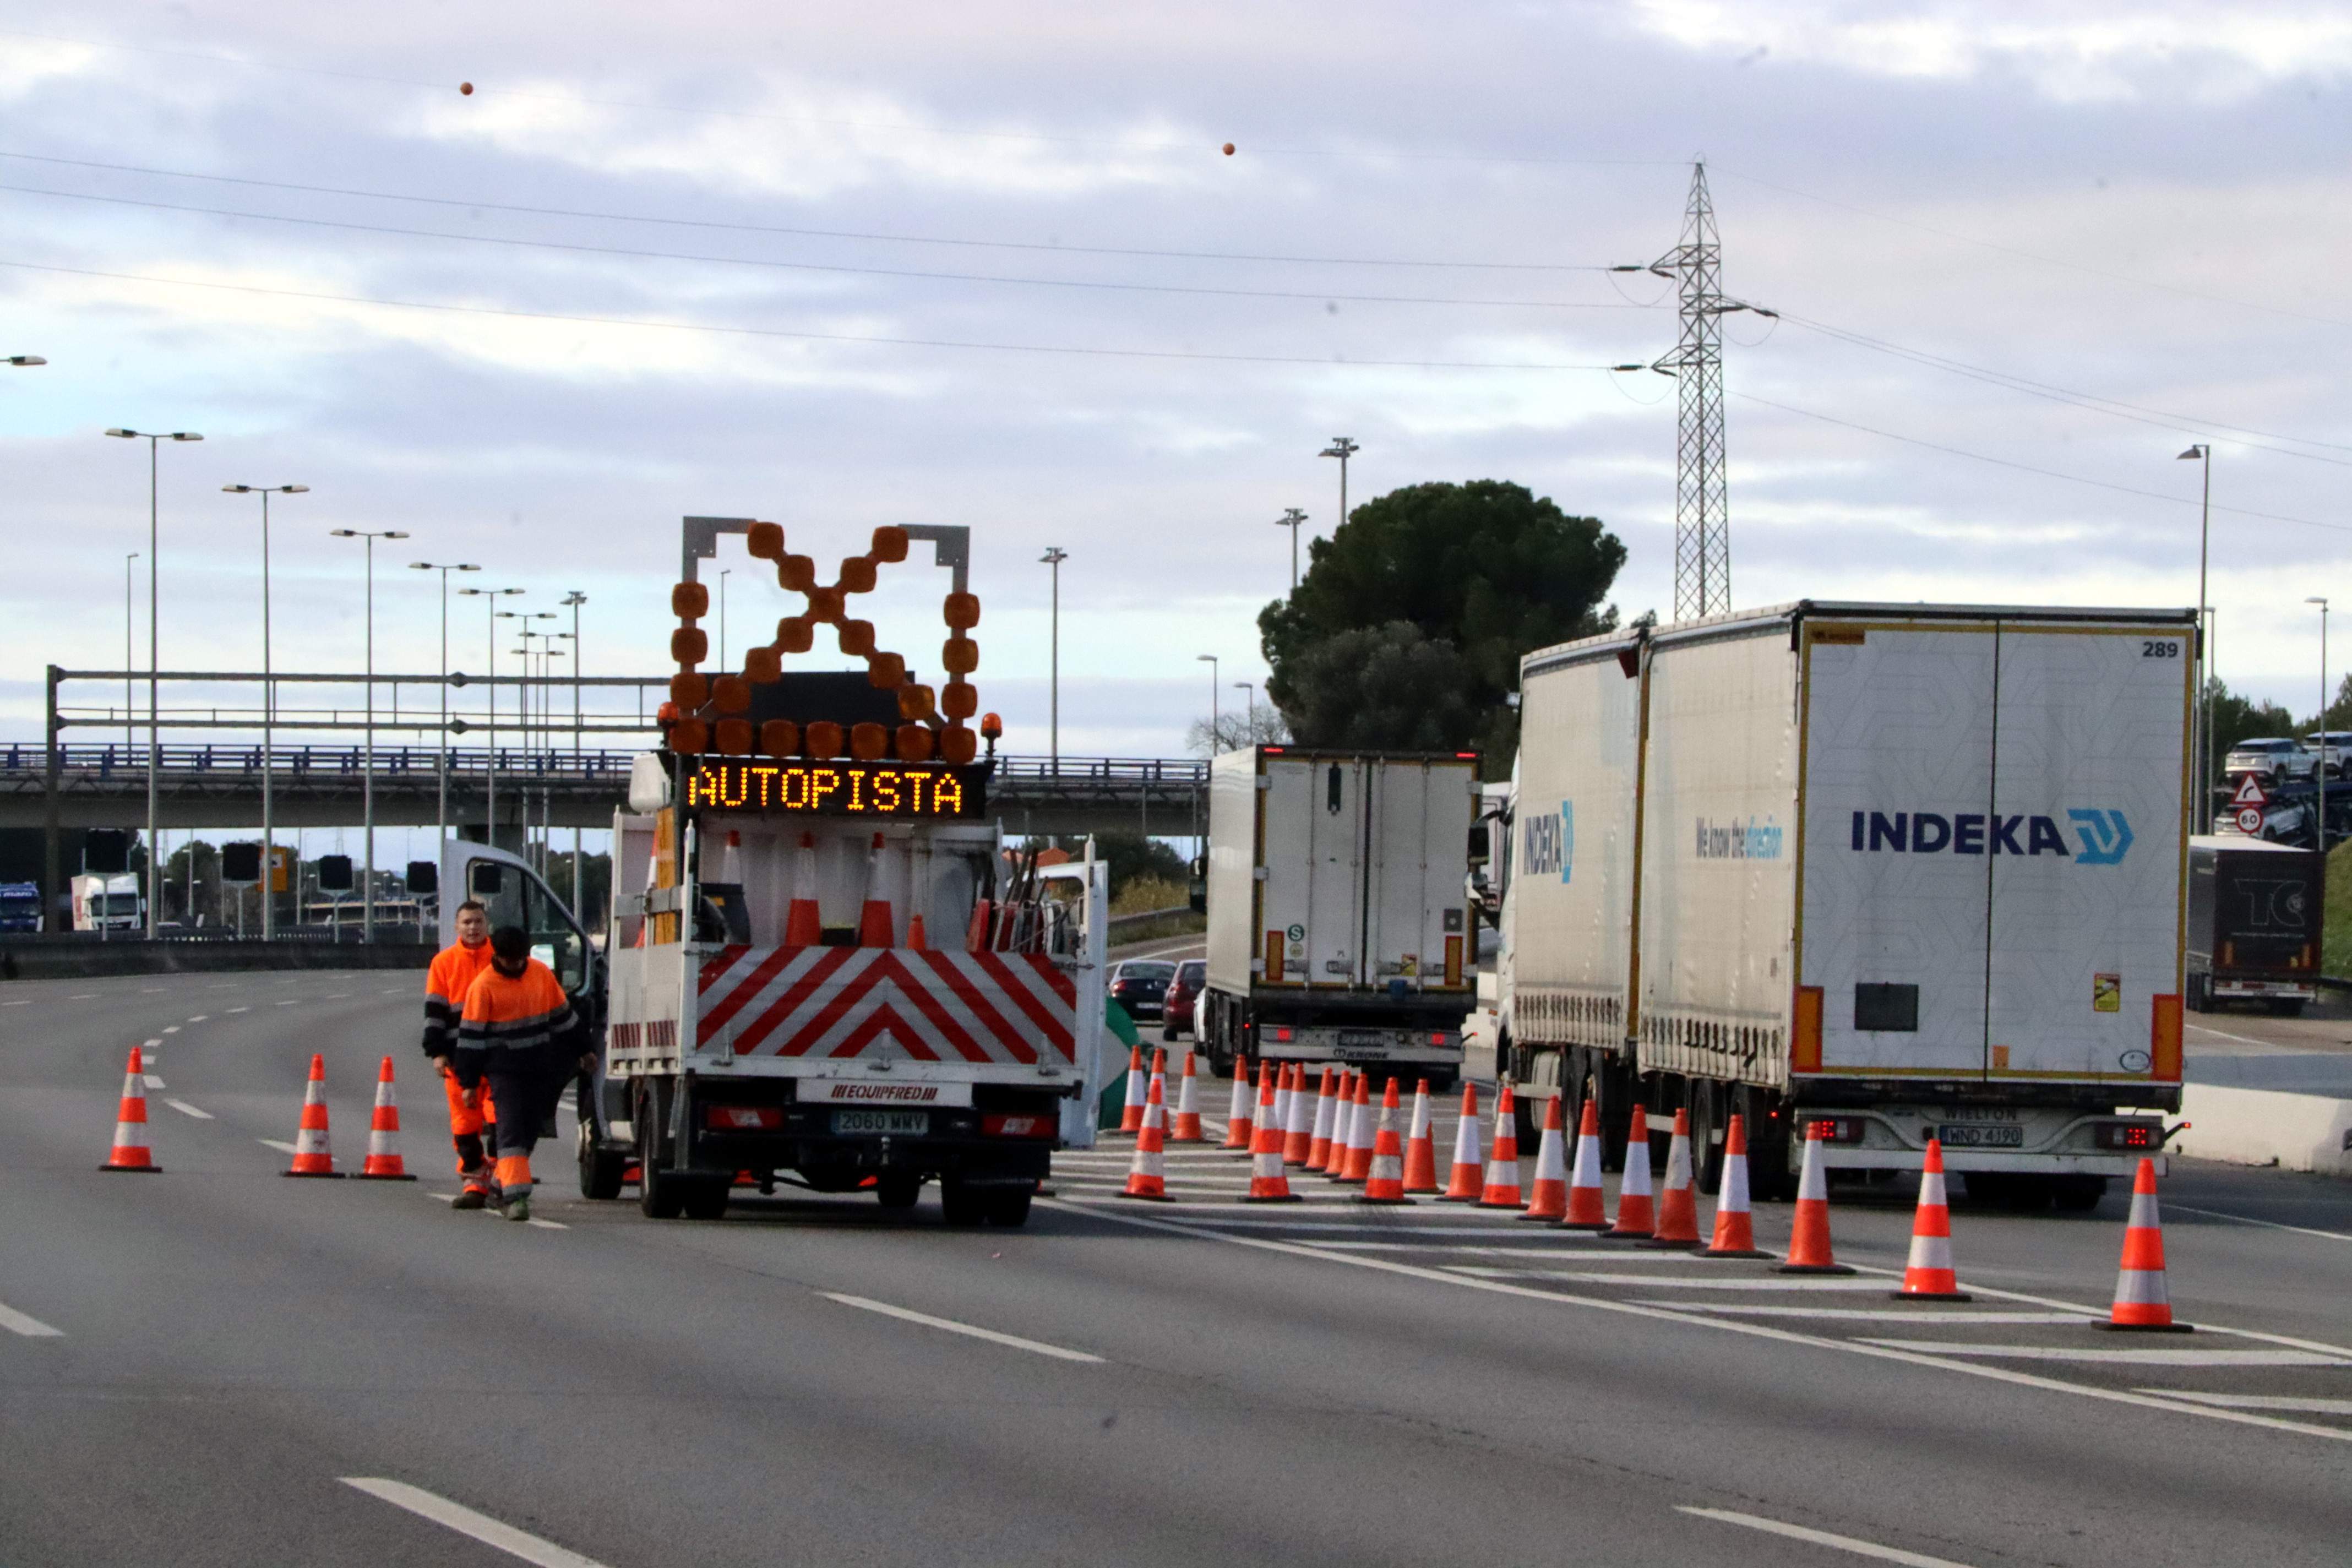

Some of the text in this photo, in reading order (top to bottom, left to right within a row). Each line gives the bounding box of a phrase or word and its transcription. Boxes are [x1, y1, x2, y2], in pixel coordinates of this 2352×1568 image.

[2143, 642, 2178, 657] 289
[689, 766, 961, 813] AUTOPISTA
[2241, 815, 2257, 824] 60
[1852, 812, 2070, 856] INDEKA
[1524, 814, 1561, 875] INDEKA
[842, 1113, 885, 1129] 2060
[1945, 1109, 2017, 1120] WIELTON
[1950, 1129, 1980, 1143] WND
